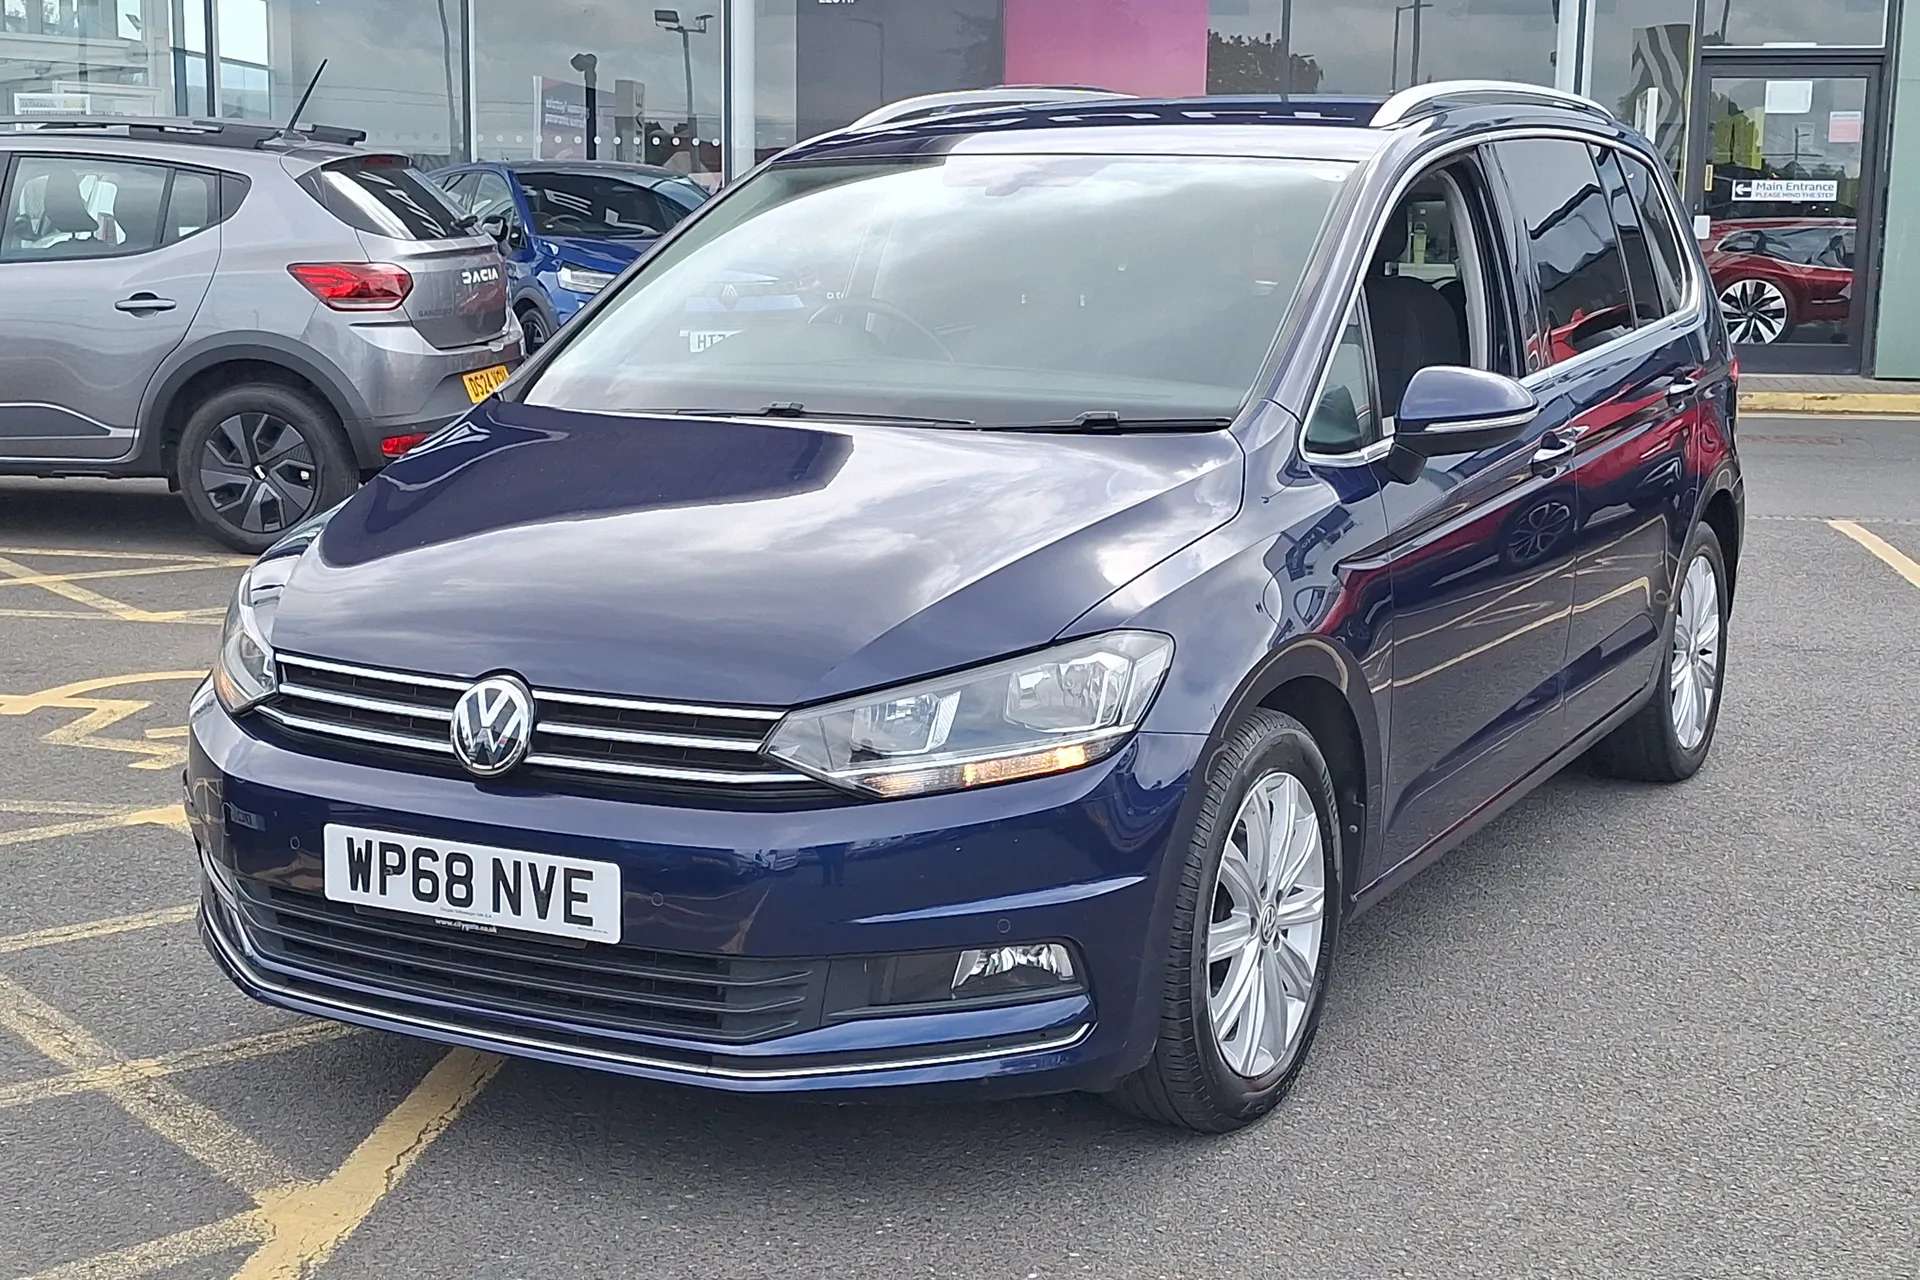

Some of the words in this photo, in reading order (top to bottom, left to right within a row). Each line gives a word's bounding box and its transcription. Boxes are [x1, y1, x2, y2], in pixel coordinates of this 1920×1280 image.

[1756, 182, 1782, 191] Main
[1786, 182, 1835, 191] Entrance
[462, 267, 499, 285] DACIA
[468, 372, 494, 398] DS24
[346, 836, 474, 909] WP68
[492, 857, 594, 927] NVE
